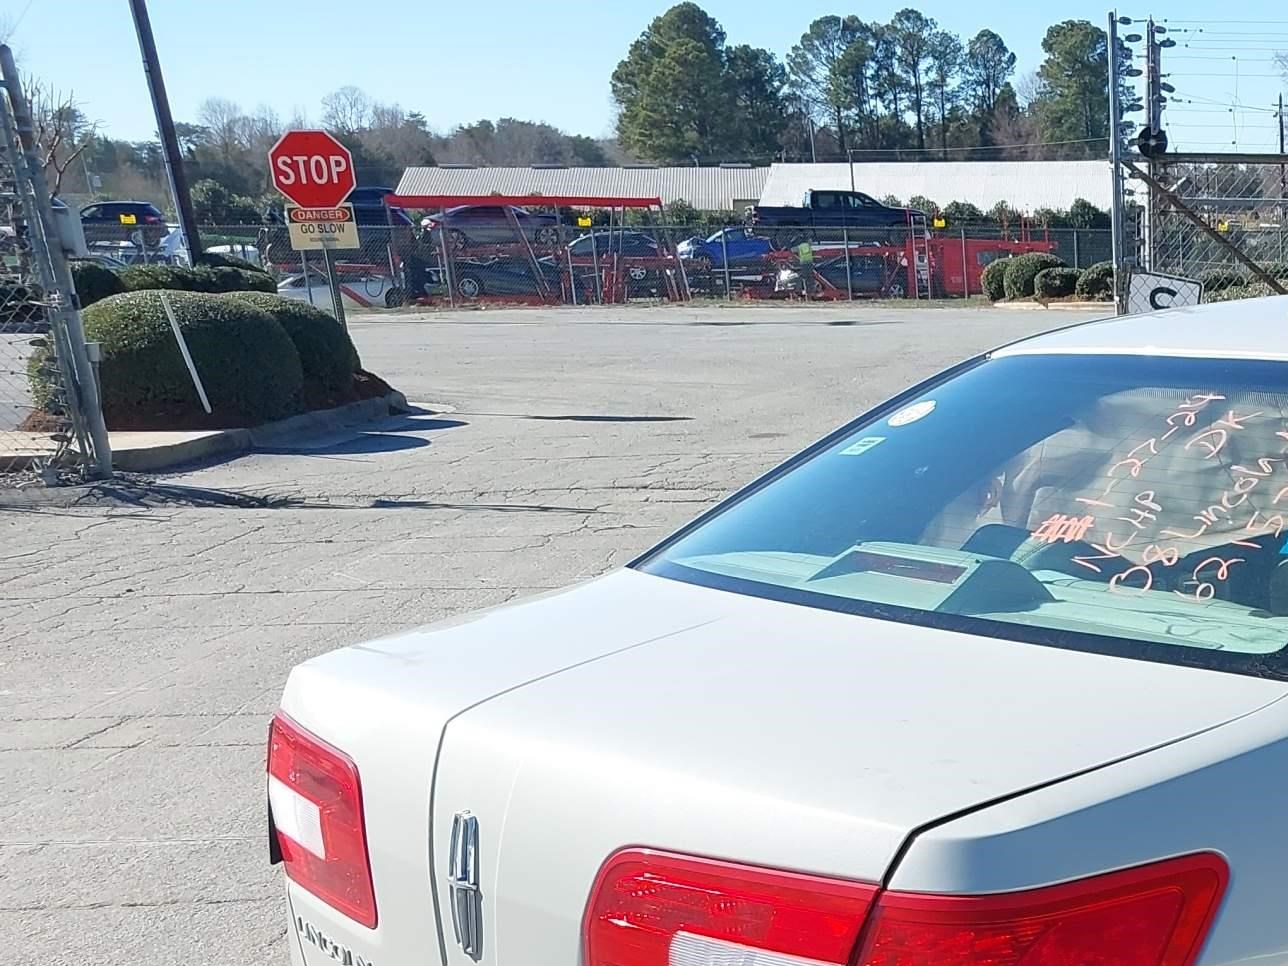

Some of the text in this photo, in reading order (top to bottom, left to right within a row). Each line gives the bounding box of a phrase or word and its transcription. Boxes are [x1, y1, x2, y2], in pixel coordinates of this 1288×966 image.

[277, 155, 346, 185] STOP
[297, 210, 343, 220] DANGER
[300, 223, 345, 234] GO SLOW
